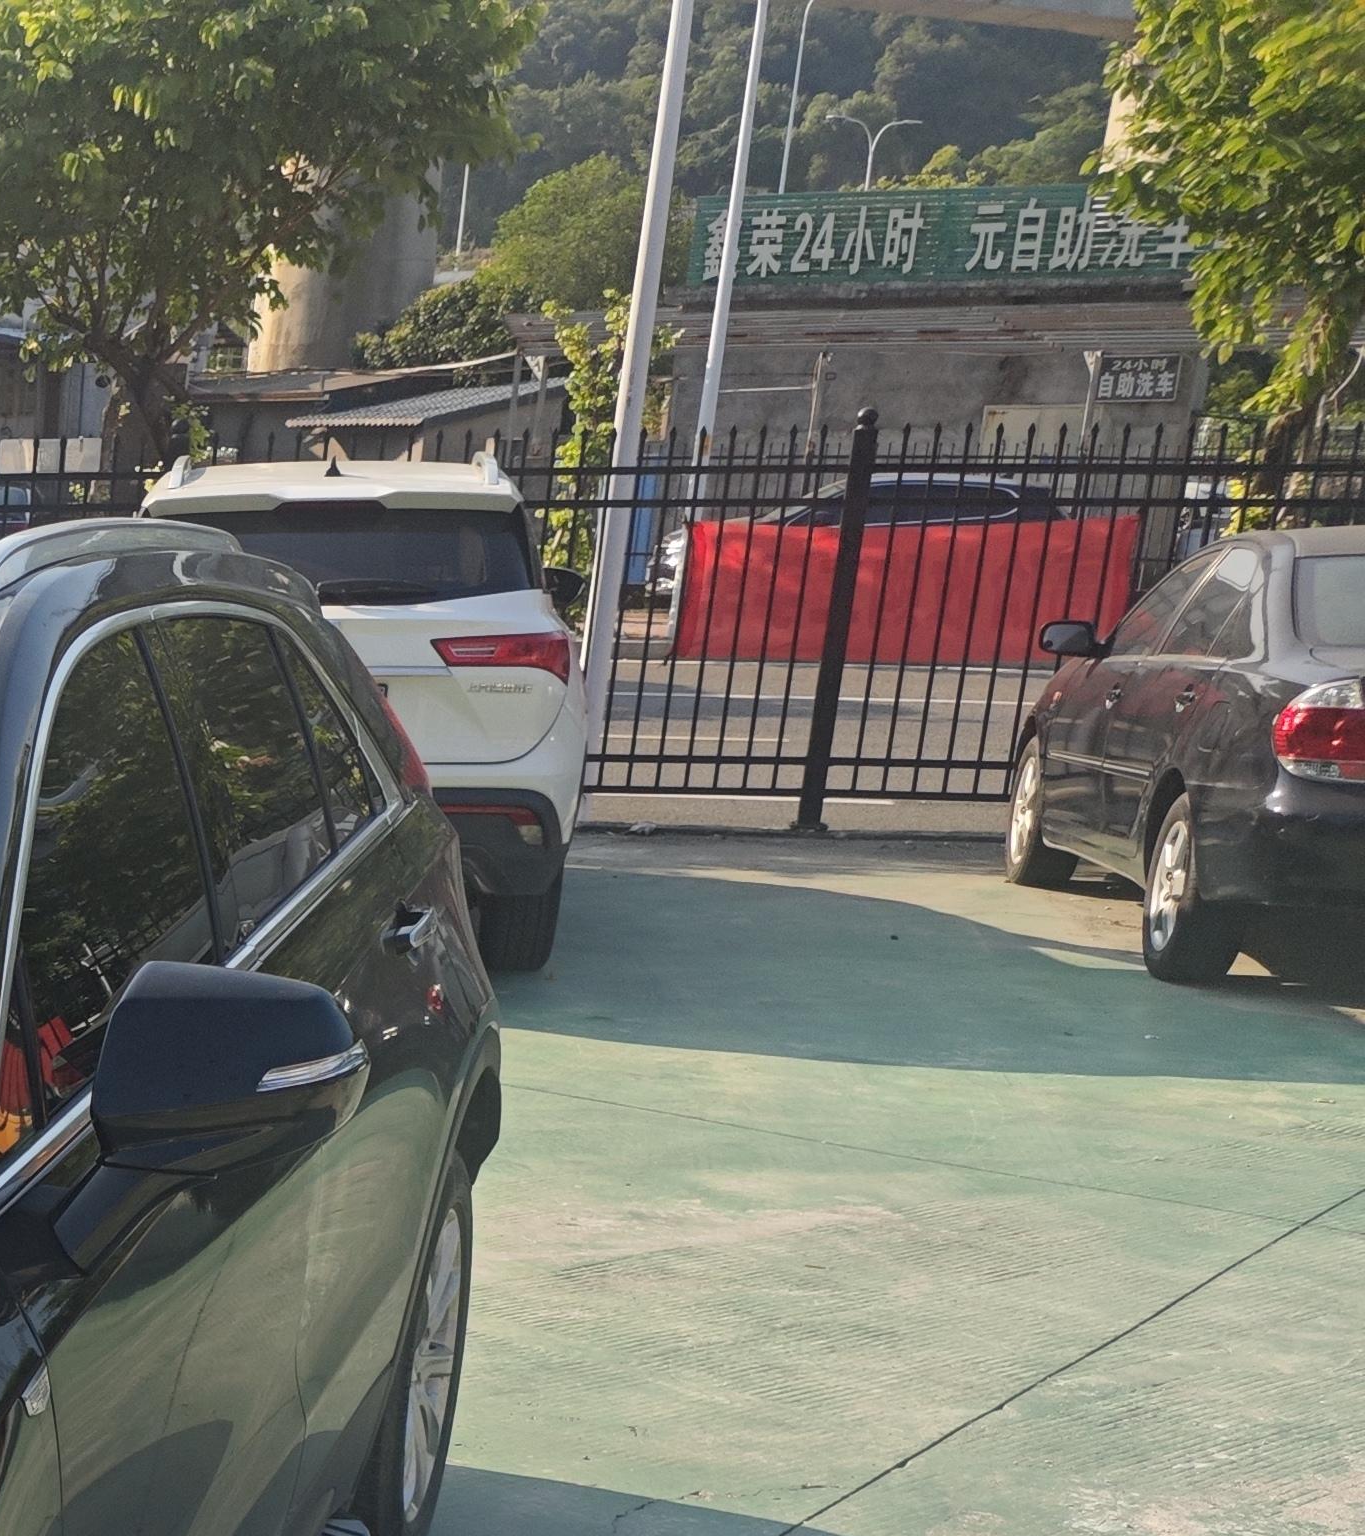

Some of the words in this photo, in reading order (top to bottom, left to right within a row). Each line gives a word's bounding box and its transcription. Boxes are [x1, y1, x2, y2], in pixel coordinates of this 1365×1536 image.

[1111, 358, 1168, 371] 24小时
[1097, 371, 1176, 398] 自助洗车
